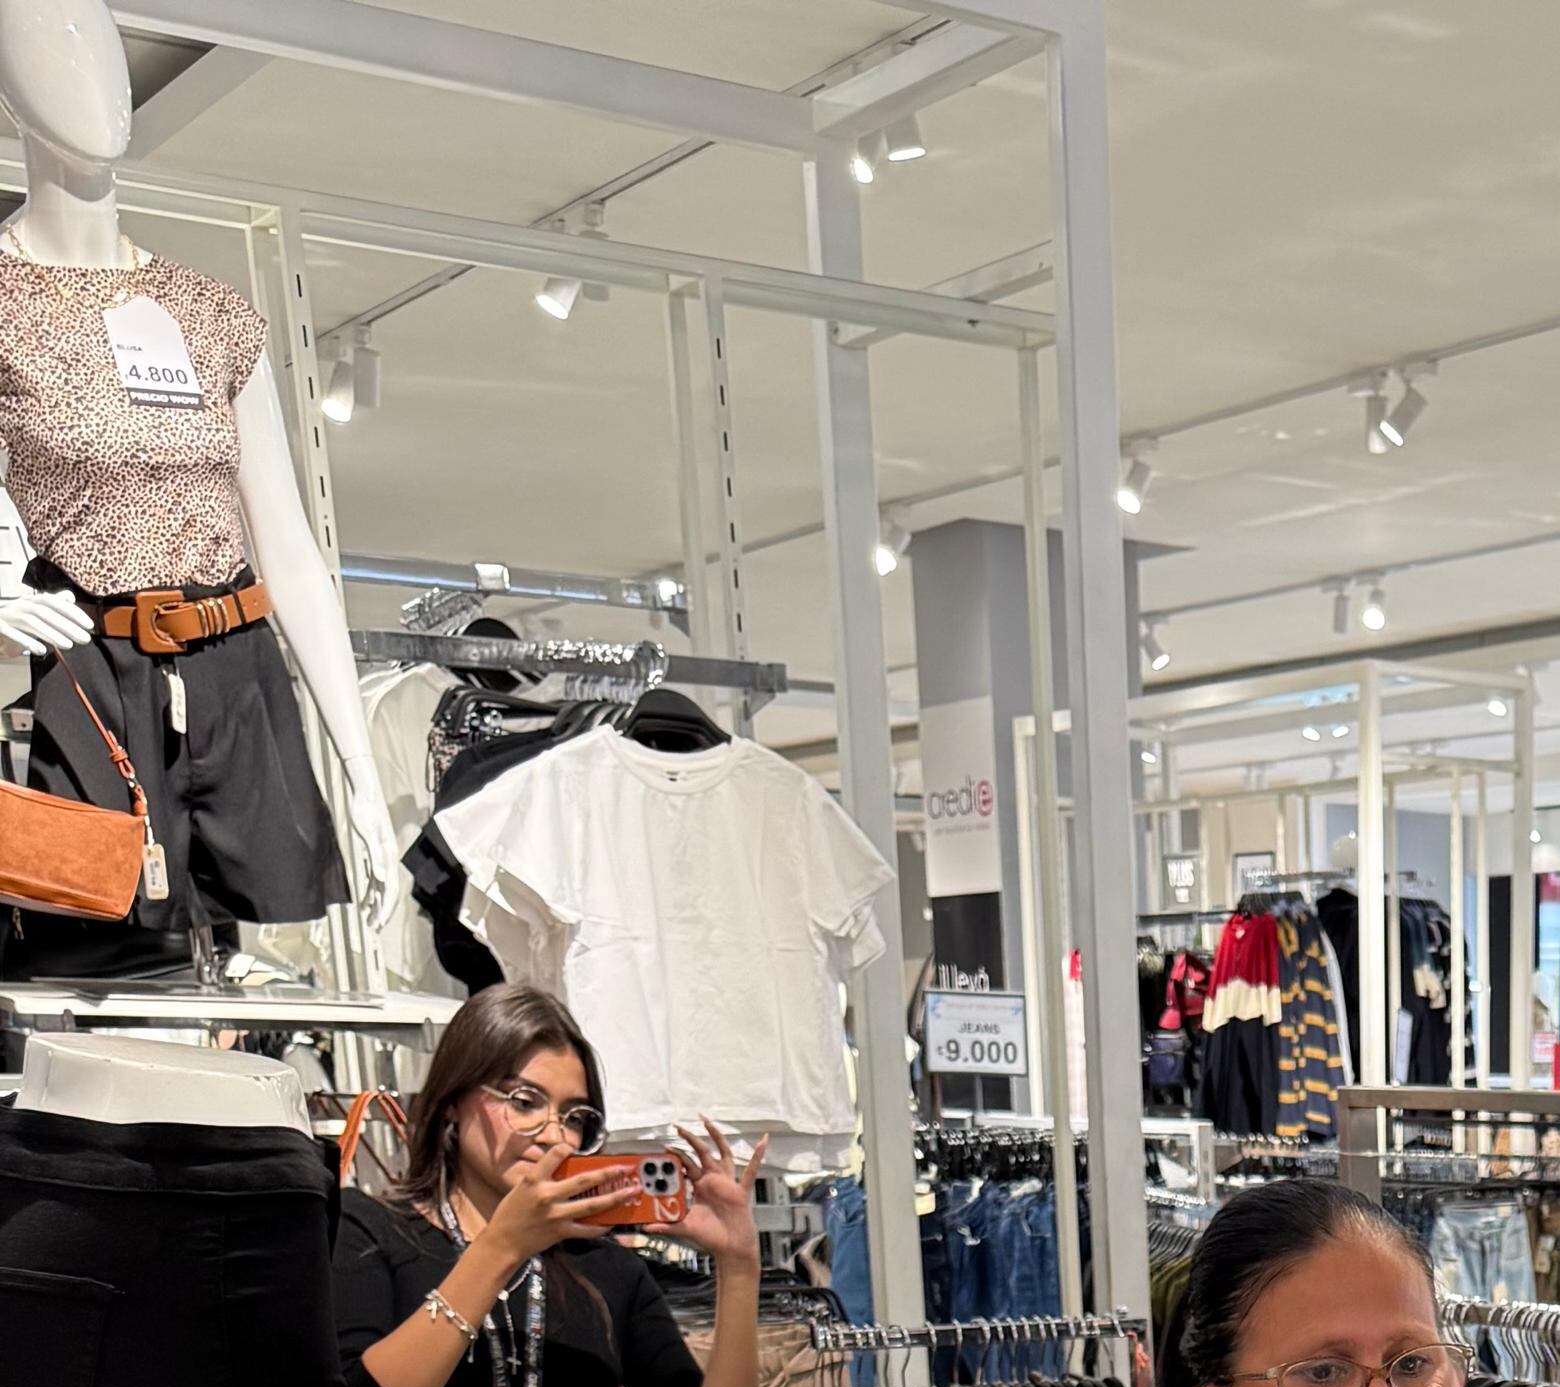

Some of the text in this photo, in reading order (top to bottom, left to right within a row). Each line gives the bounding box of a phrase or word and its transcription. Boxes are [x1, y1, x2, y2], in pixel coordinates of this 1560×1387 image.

[129, 391, 200, 405] PRECIO WOW
[958, 1022, 1000, 1034] JEANS
